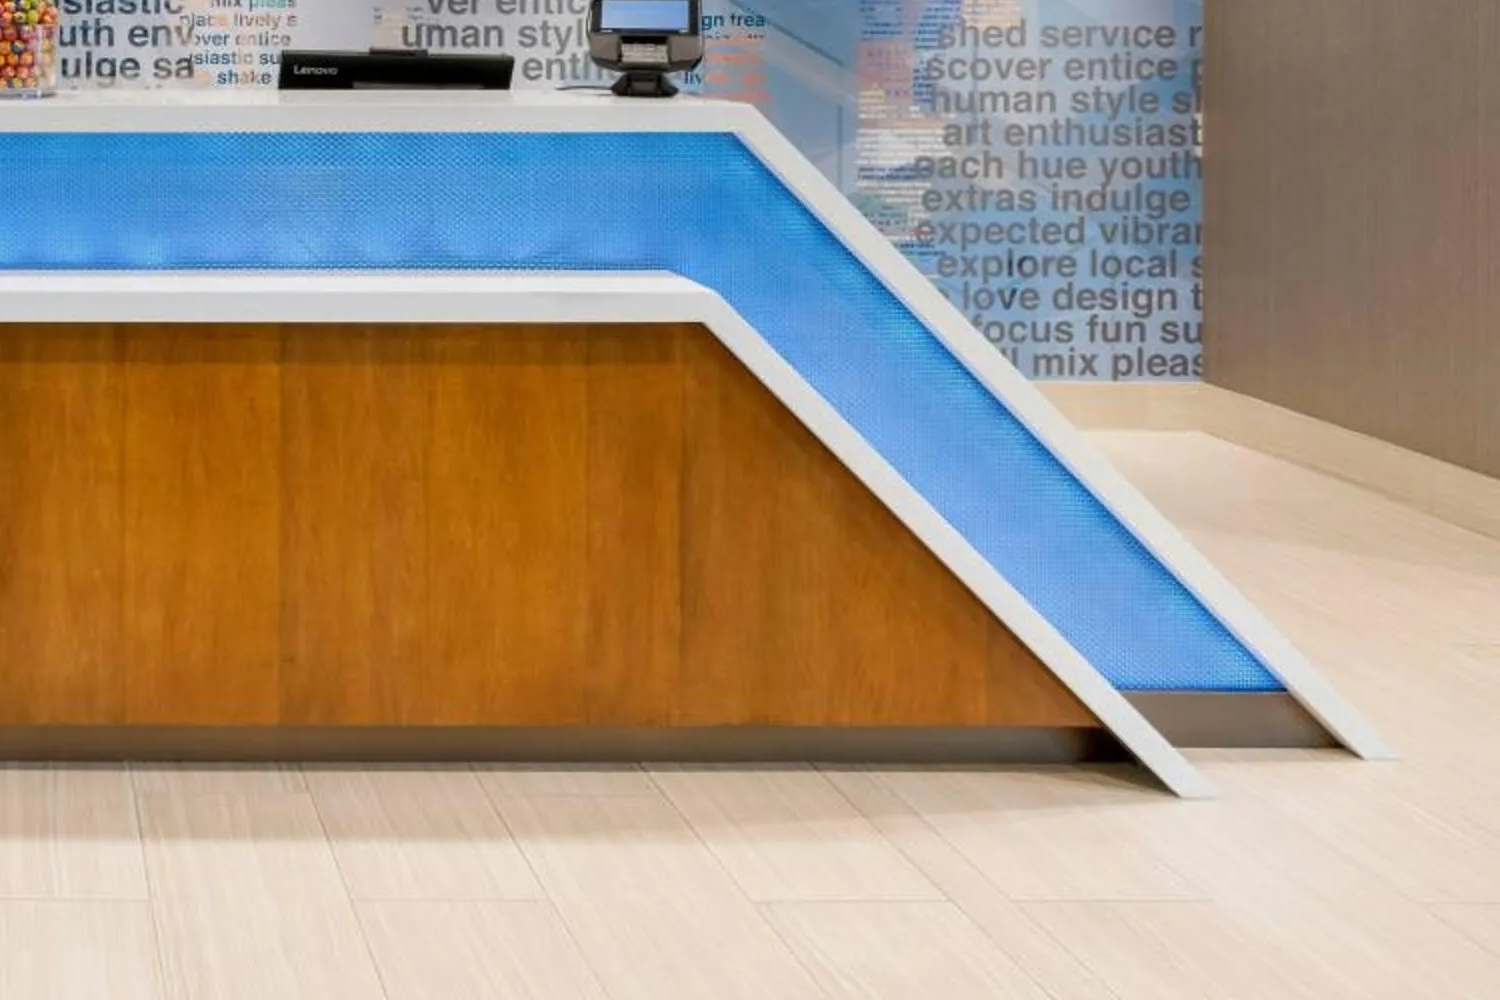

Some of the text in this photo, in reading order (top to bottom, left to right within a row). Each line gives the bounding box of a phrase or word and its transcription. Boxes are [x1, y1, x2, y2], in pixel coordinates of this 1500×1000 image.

[59, 20, 114, 47] uth
[401, 18, 584, 55] uman styl
[938, 18, 1026, 48] shed
[1040, 22, 1175, 48] service
[60, 51, 147, 79] ulge
[293, 65, 338, 75] Lenovo
[927, 56, 1052, 81] scover
[1064, 52, 1178, 81] entice
[931, 85, 1202, 120] human style s
[943, 118, 1203, 147] art enthusiast
[914, 151, 1003, 180] each
[1019, 151, 1087, 180] hue
[1099, 151, 1202, 187] youth
[922, 183, 1189, 219] extras indulge
[915, 217, 1084, 253] expected
[938, 249, 1077, 283] explore
[1091, 248, 1176, 278] local
[963, 283, 1039, 311] love
[1052, 283, 1177, 318] design
[1087, 316, 1146, 342] fun
[1034, 348, 1097, 376] mix
